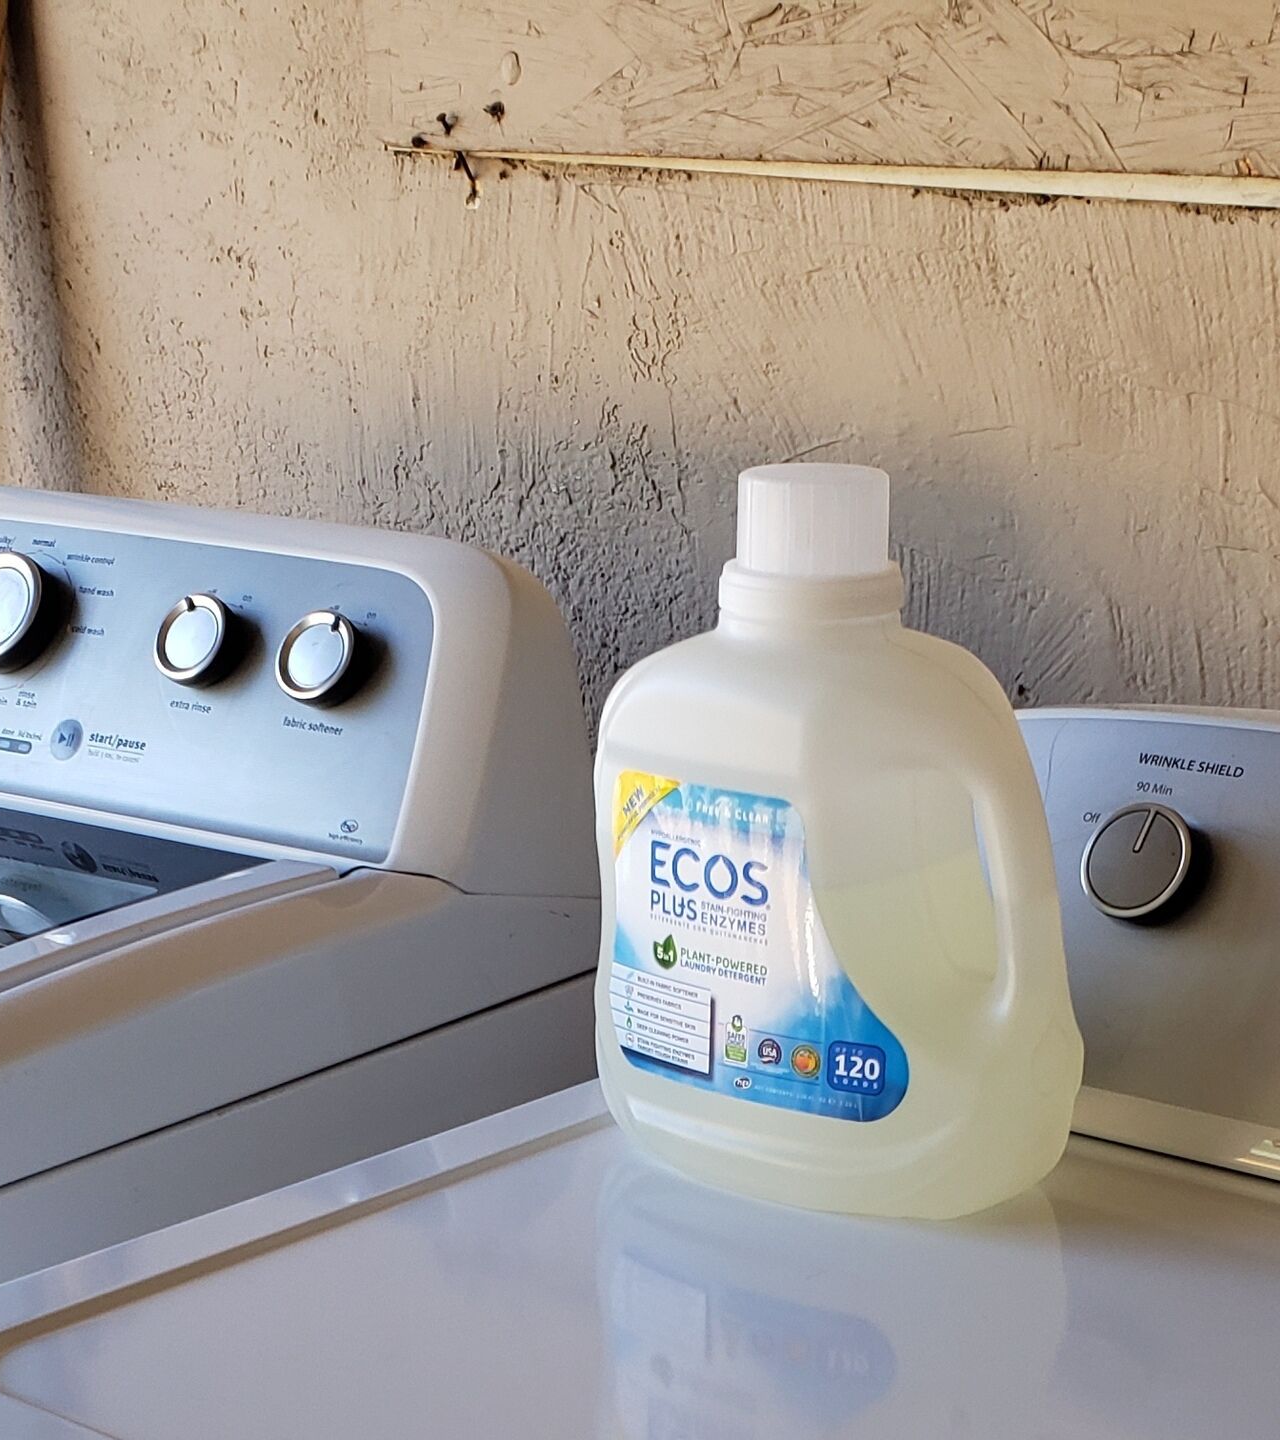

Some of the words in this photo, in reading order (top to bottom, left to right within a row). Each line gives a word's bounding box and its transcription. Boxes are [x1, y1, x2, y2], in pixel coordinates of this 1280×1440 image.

[170, 700, 190, 711] extra
[192, 701, 212, 714] rinse
[282, 716, 306, 731] fabric
[308, 721, 343, 736] softener
[88, 732, 147, 750] start/pause
[1139, 752, 1196, 772] WRINKLE
[1197, 761, 1245, 778] SHIELD
[1136, 781, 1150, 793] 90
[1151, 782, 1173, 795] Min
[623, 784, 645, 817] NEW
[735, 808, 768, 824] CLEAR
[1082, 811, 1102, 824] Off
[650, 840, 769, 906] ECOS
[650, 889, 697, 920] PLUS
[700, 901, 767, 922] STAIN-FIGHTING
[700, 911, 766, 936] ENZYMES
[680, 947, 768, 976] PLANT-POWERED
[680, 960, 716, 975] LAUNDRY
[718, 967, 766, 987] DETERGENT
[673, 986, 698, 998] SOFTENER
[762, 1047, 777, 1057] USA
[835, 1054, 880, 1080] 120
[833, 1076, 878, 1089] LOADS
